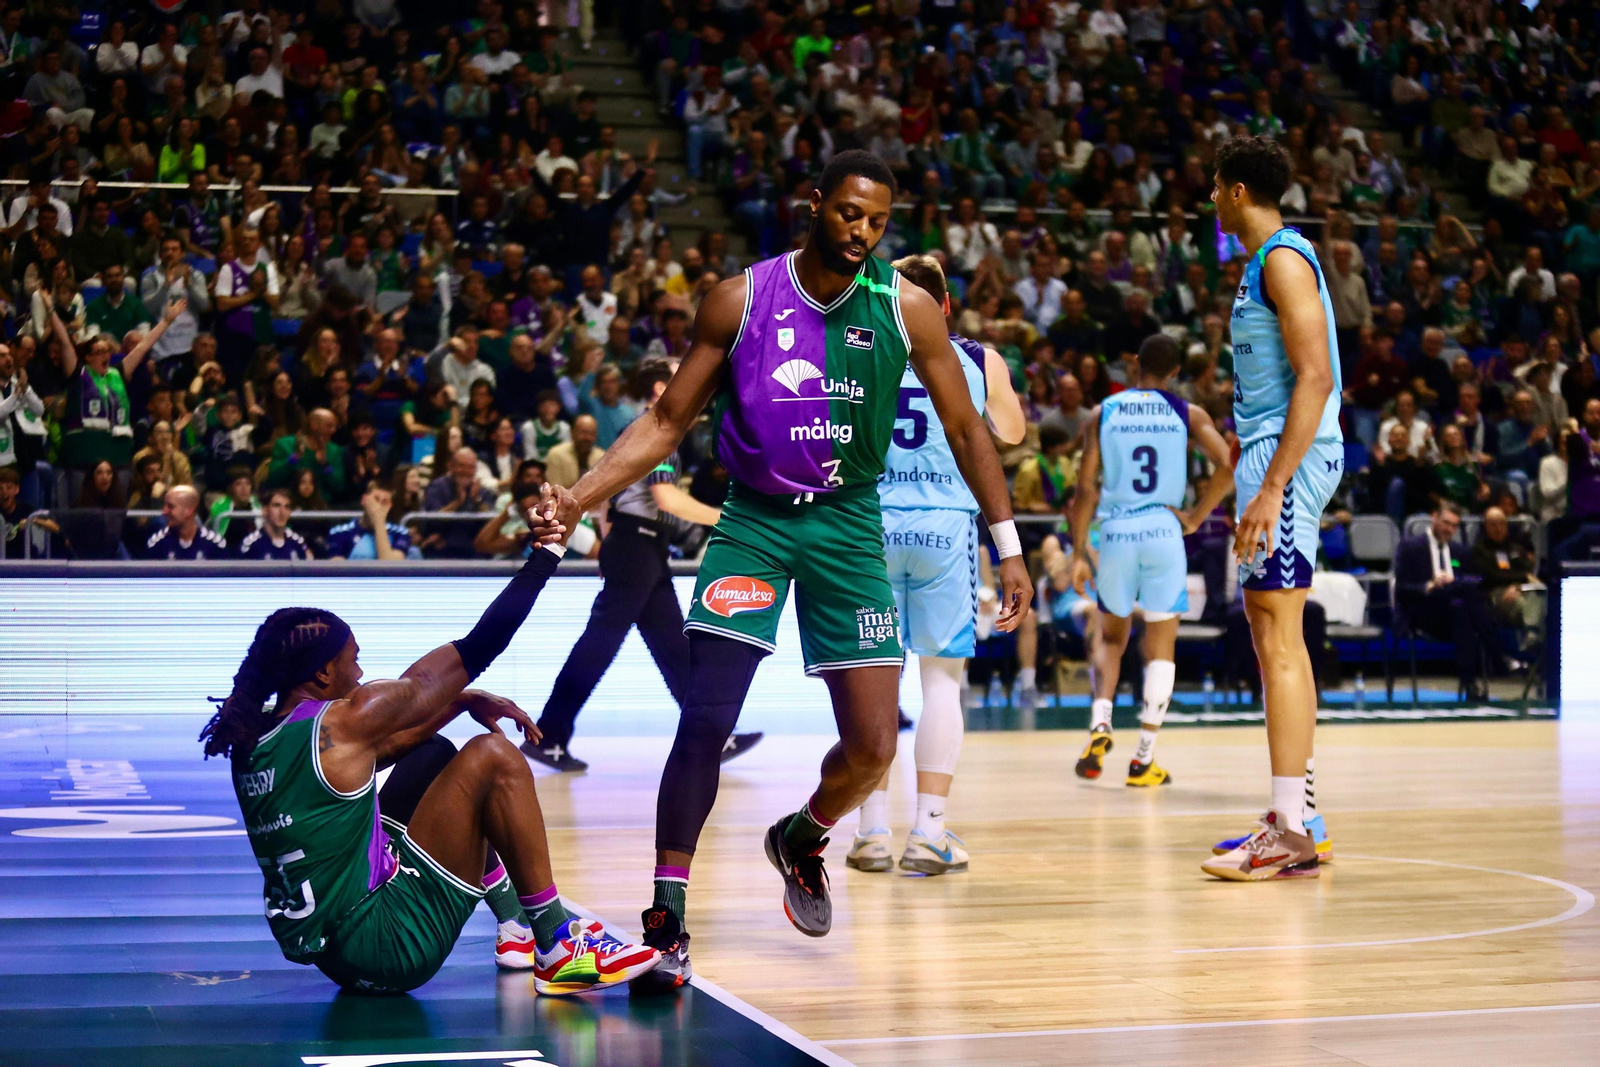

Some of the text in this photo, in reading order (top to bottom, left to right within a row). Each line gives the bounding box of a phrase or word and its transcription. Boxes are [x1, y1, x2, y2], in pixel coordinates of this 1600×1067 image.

[892, 387, 930, 450] 5
[1119, 402, 1173, 416] MONTERO
[888, 466, 953, 486] Andorra
[1132, 445, 1158, 494] 3
[707, 579, 774, 605] famadesa
[855, 606, 875, 615] sabor
[856, 614, 863, 622] a
[237, 767, 276, 797] PERRY
